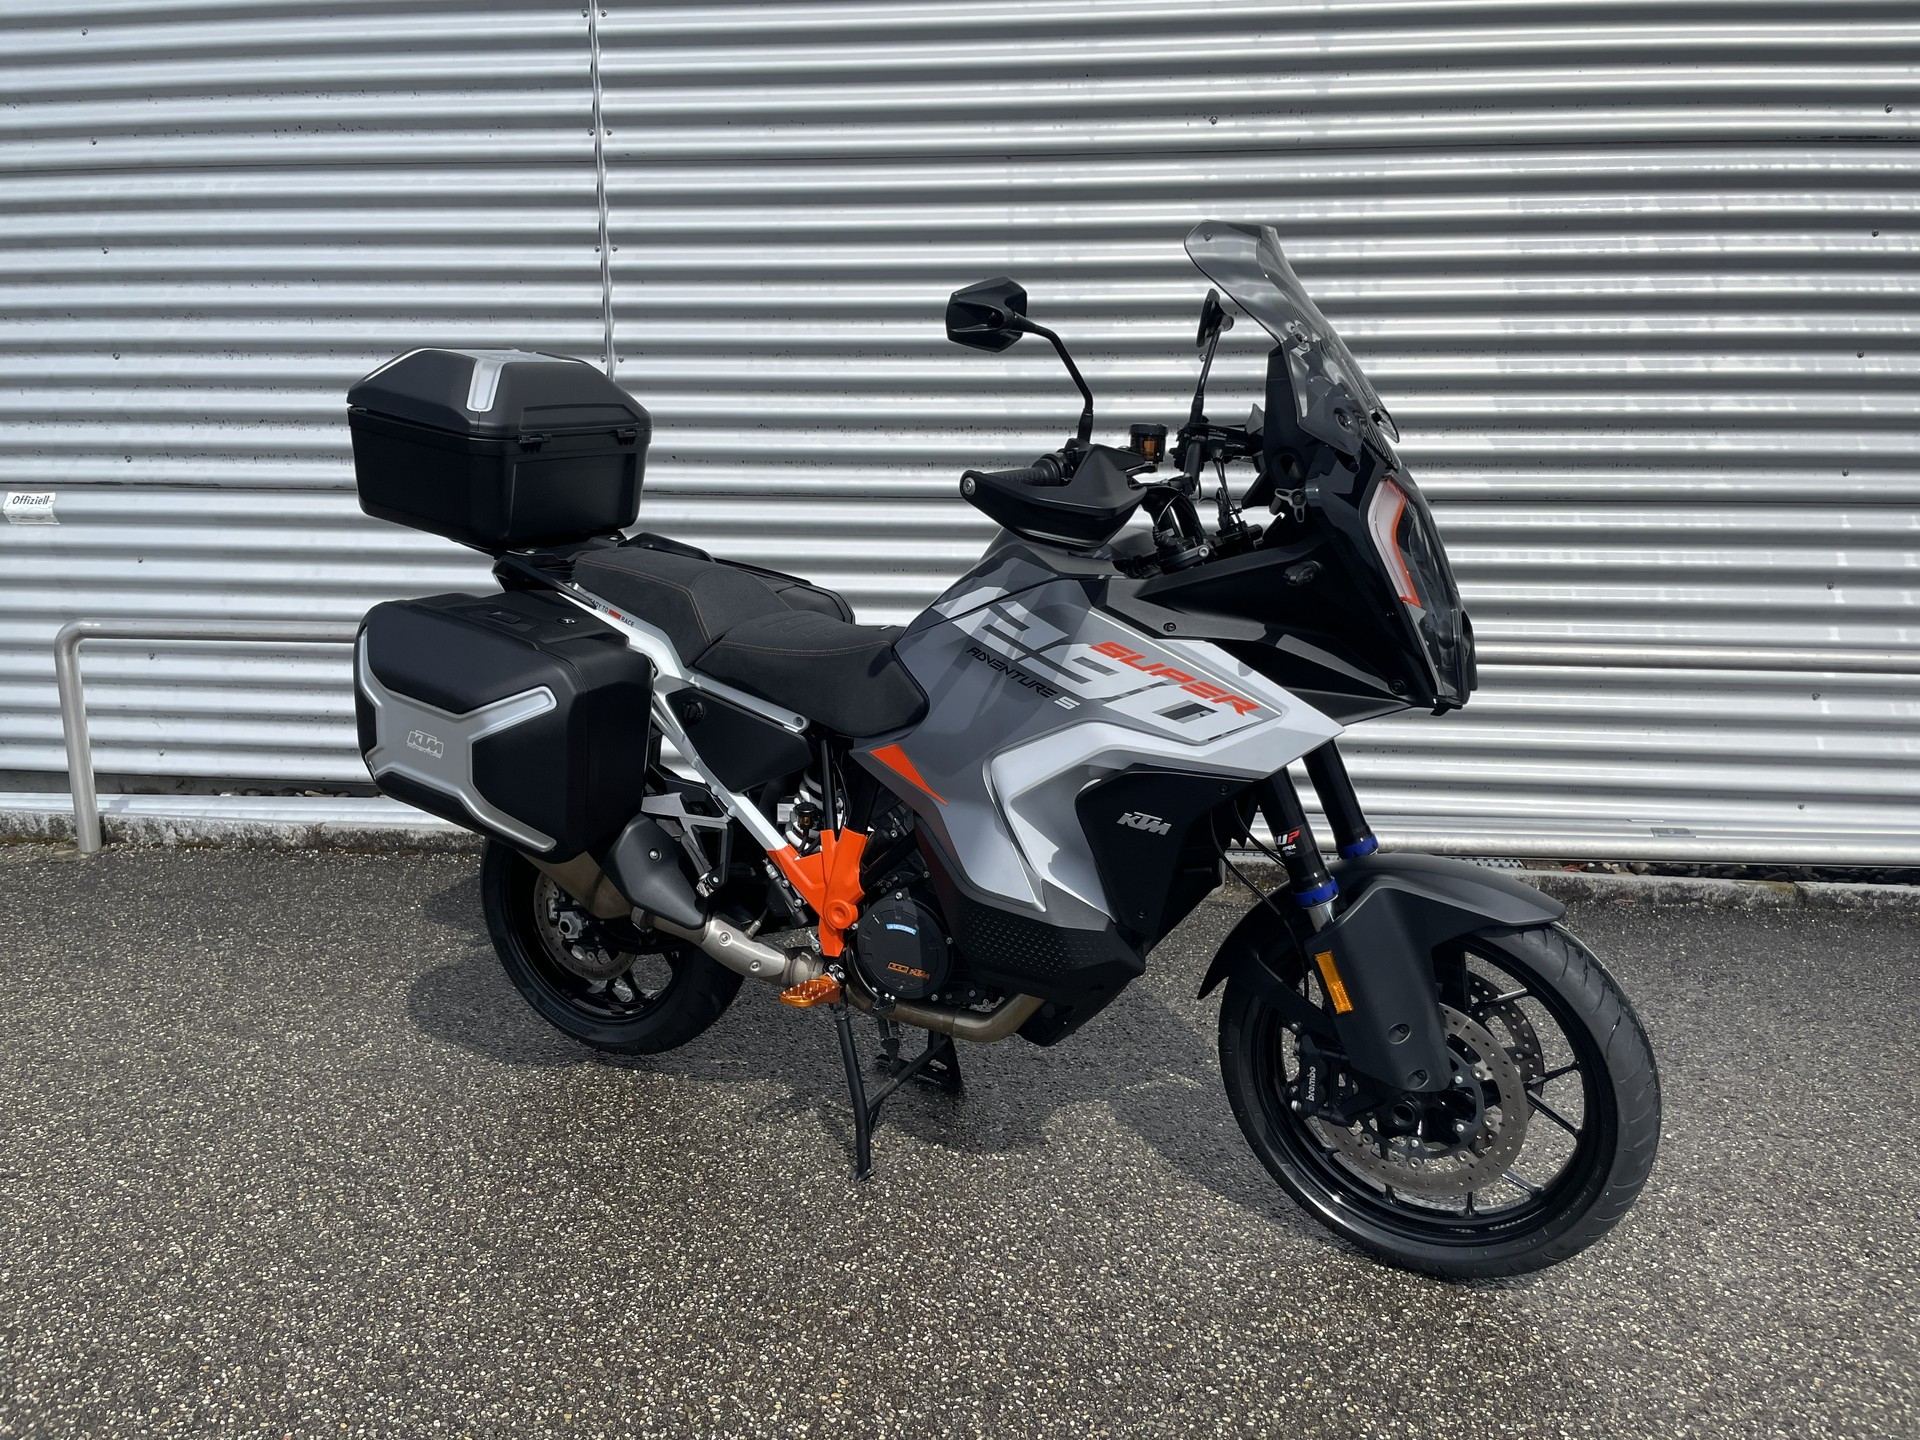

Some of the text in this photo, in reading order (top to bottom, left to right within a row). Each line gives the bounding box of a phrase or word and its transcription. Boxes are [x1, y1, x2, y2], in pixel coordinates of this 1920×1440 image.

[12, 495, 50, 505] Offiziell
[621, 616, 635, 627] RACE
[967, 647, 1080, 710] ADVENTURE S
[1088, 641, 1261, 716] SUPER
[407, 729, 444, 757] KTM
[1116, 811, 1172, 835] KTM
[1306, 1066, 1316, 1101] brembo
